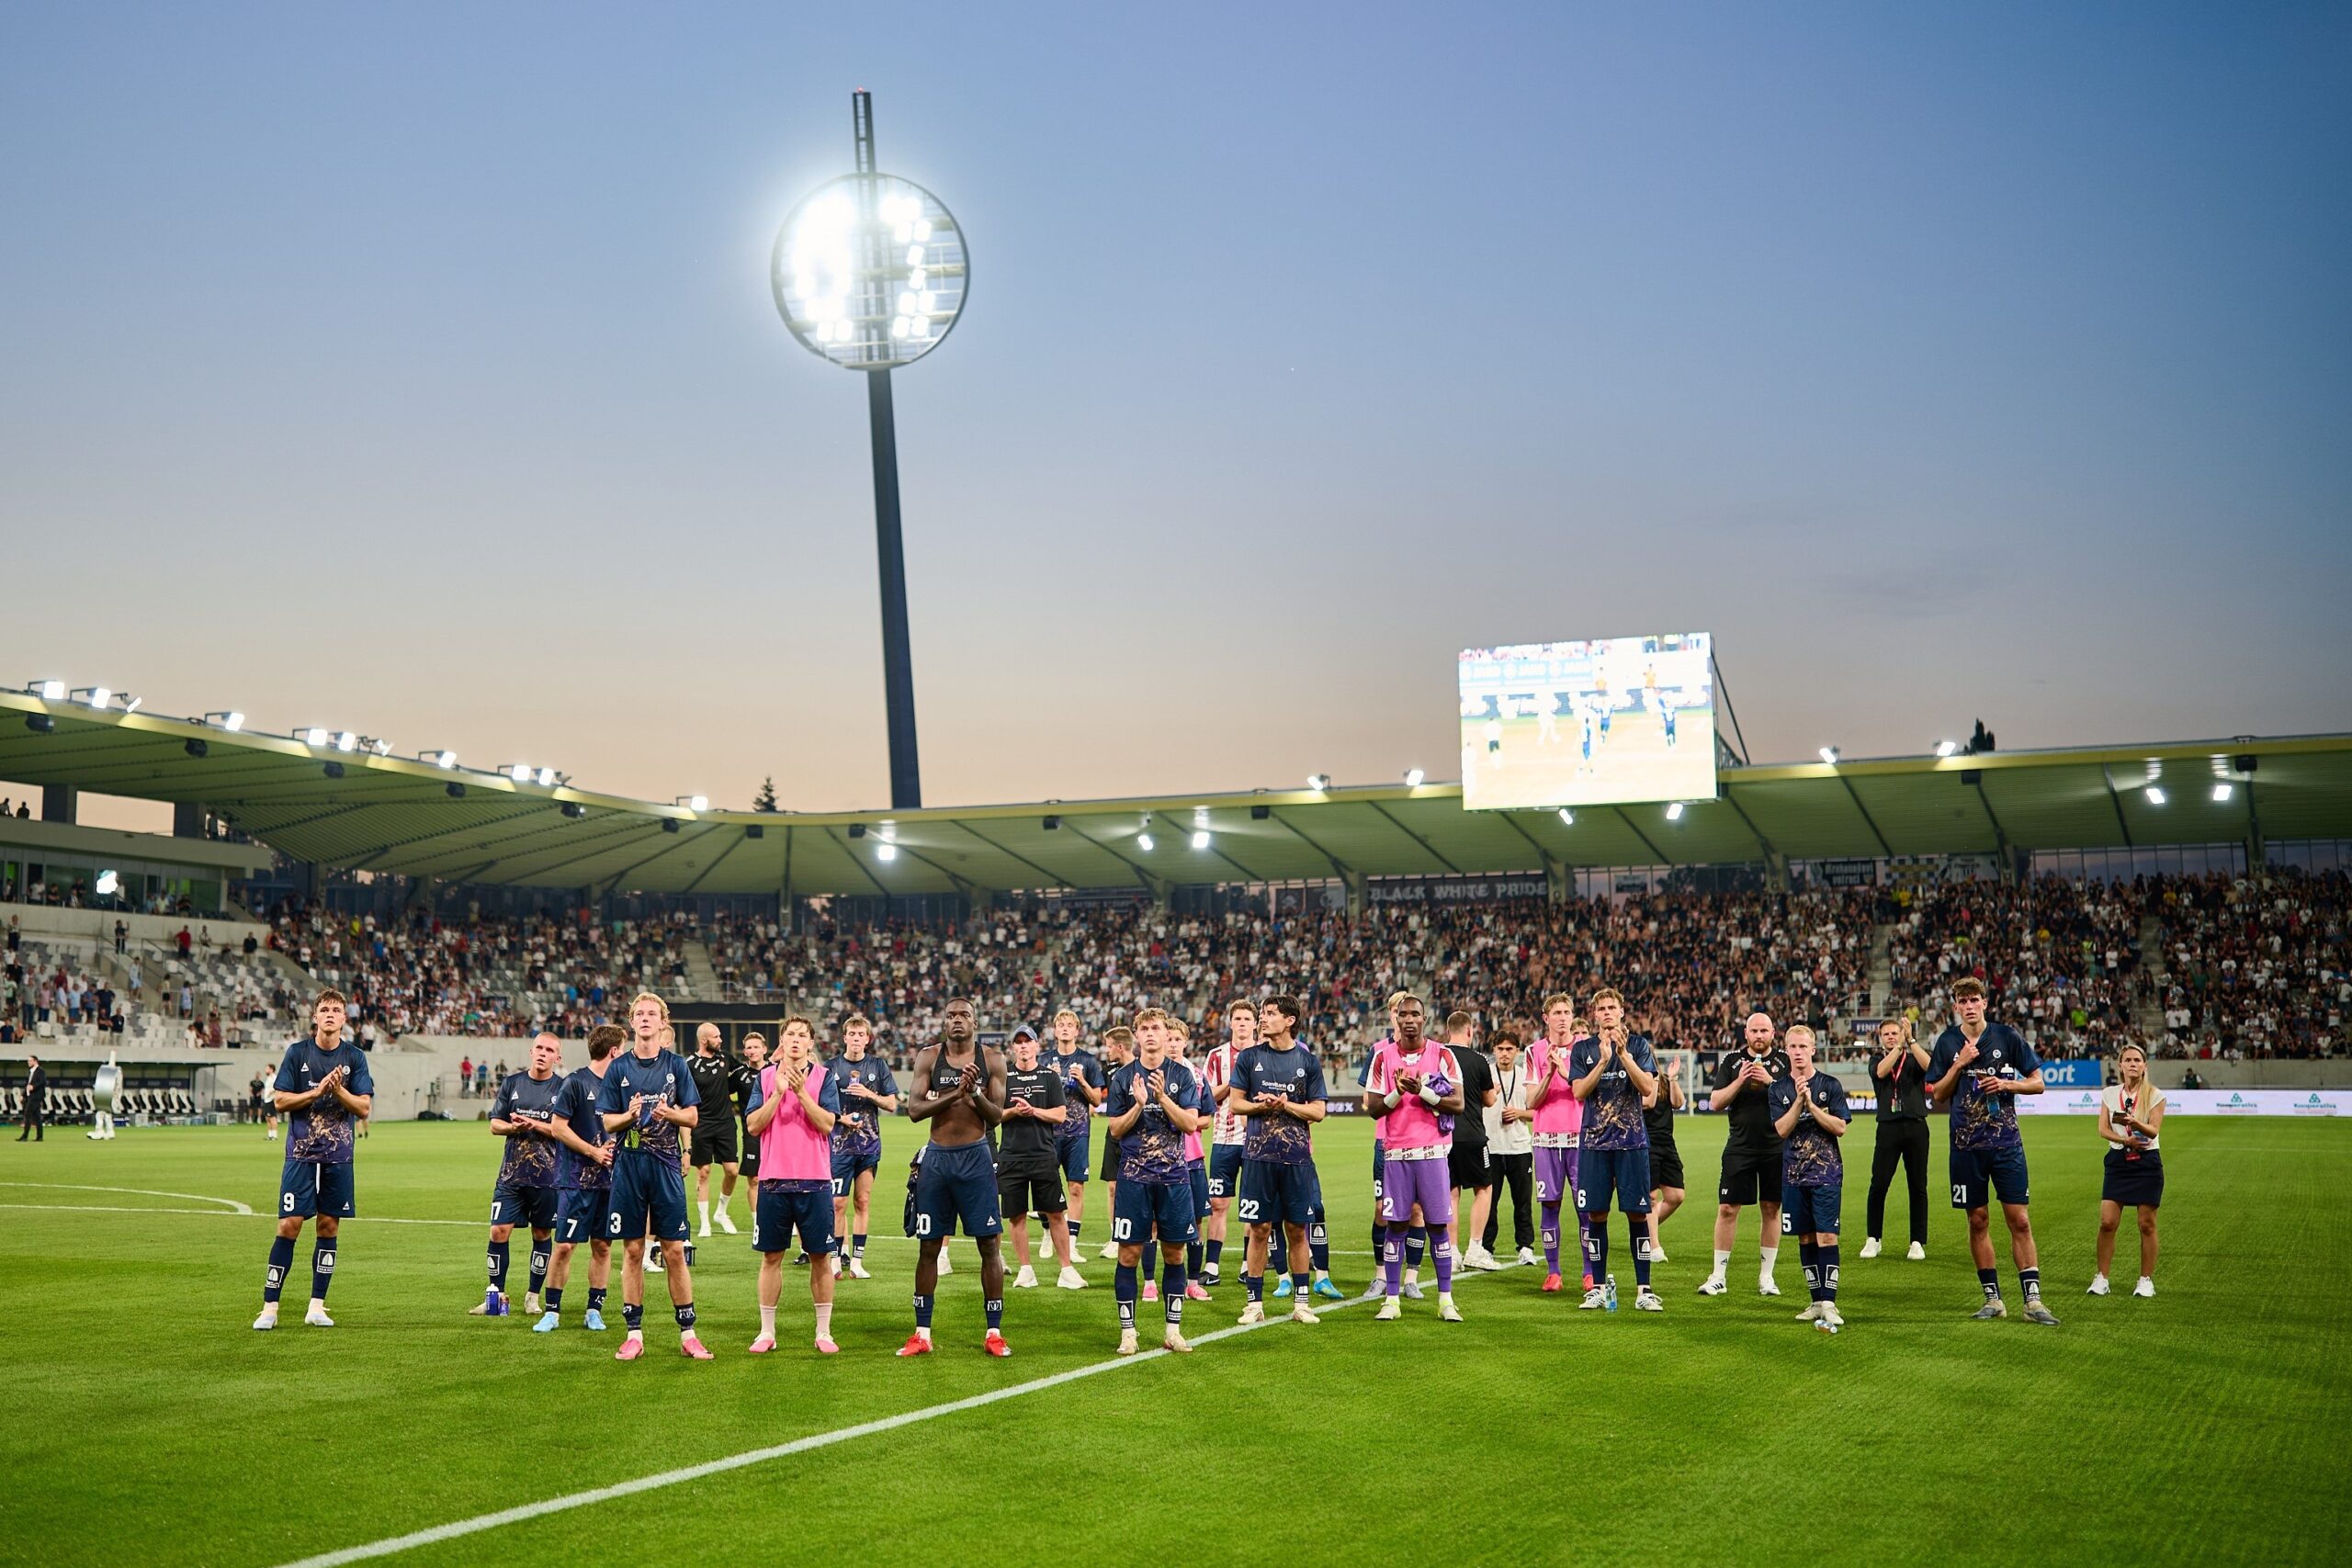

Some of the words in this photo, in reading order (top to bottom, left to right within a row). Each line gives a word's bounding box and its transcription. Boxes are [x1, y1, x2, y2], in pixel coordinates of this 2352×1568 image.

[1369, 886, 1426, 901] BLACK
[1433, 884, 1489, 899] WHITE
[1495, 882, 1547, 898] PRIDE
[1209, 1179, 1224, 1195] 25
[1952, 1184, 1966, 1203] 21
[284, 1192, 295, 1212] 9
[1382, 1197, 1394, 1216] 2
[1577, 1190, 1586, 1208] 6
[1238, 1199, 1259, 1219] 22
[566, 1218, 578, 1238] 7
[610, 1213, 621, 1234] 3
[1114, 1217, 1131, 1239] 10
[1782, 1213, 1792, 1232] 5
